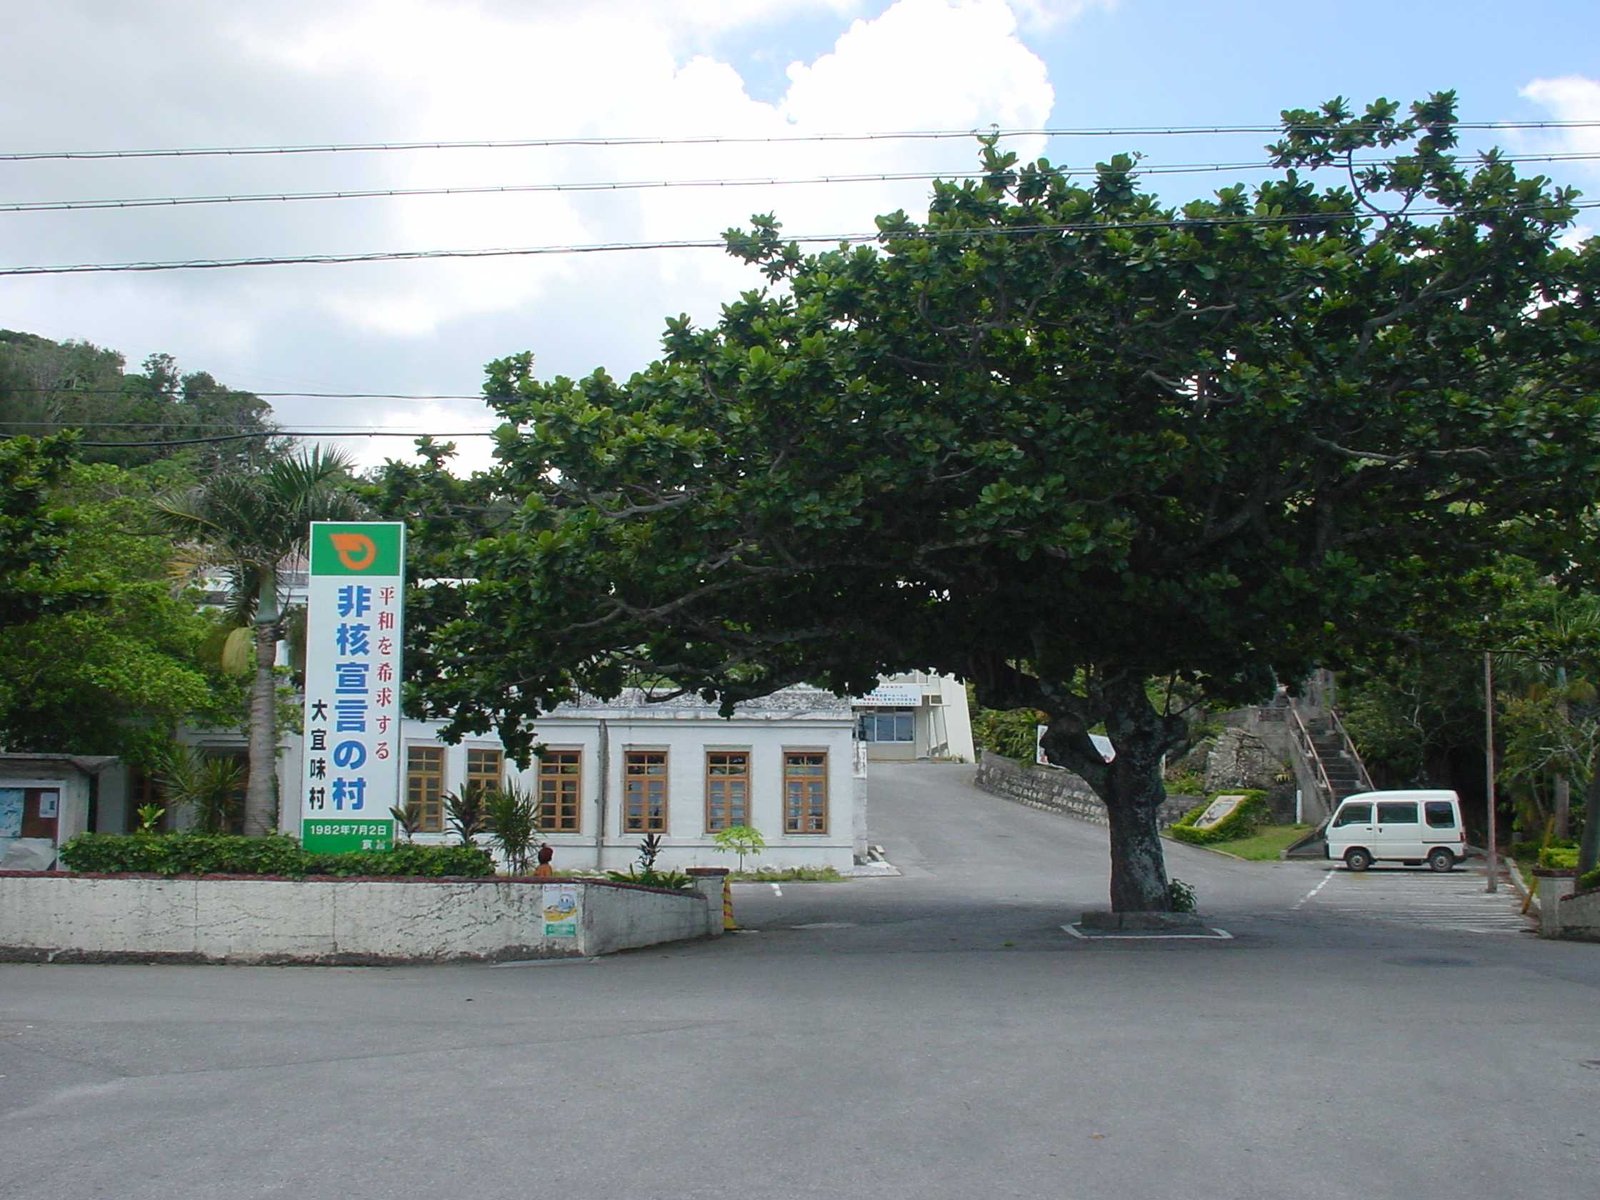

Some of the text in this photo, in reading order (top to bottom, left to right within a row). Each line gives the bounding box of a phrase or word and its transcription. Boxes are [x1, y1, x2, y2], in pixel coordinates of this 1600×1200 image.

[332, 585, 372, 810] 非核宣言の村
[375, 586, 395, 760] 平和を希求する
[309, 699, 328, 810] 大宜味村
[310, 825, 387, 835] 1982年7月2日
